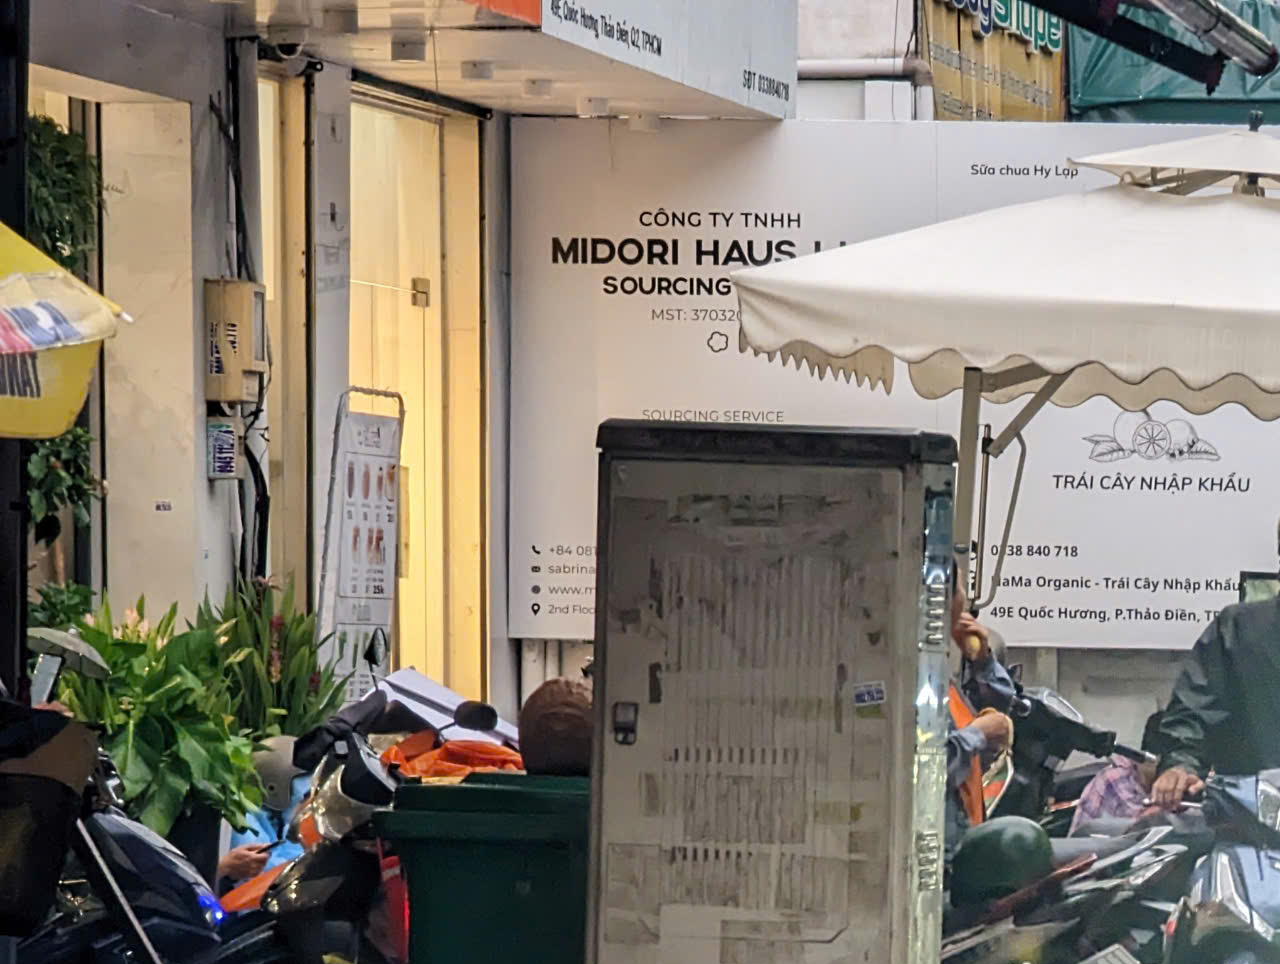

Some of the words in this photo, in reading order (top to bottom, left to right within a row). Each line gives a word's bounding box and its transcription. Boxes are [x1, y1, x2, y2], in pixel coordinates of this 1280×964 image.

[970, 163, 996, 176] Sữa
[999, 164, 1030, 176] chua
[1034, 164, 1052, 178] Hy
[1055, 164, 1079, 180] Lạp
[639, 207, 702, 228] CÔNG
[708, 211, 735, 228] TY
[740, 212, 801, 229] TNHH
[551, 236, 679, 266] MIDORI
[695, 239, 797, 267] HAUS
[602, 275, 732, 296] SOURCING
[651, 308, 688, 321] MST:
[642, 409, 720, 422] SOURCING
[723, 410, 785, 423] SERVICE
[1052, 471, 1094, 489] TRÁI
[1099, 472, 1136, 490] CÂY
[1139, 473, 1193, 495] NHẬP
[1198, 472, 1250, 492] KHẨU
[549, 545, 573, 557] +84
[990, 544, 1023, 556] 038
[1026, 545, 1051, 557] 840
[1054, 545, 1079, 558] 718
[992, 575, 1032, 588] aMa
[1036, 575, 1092, 592] Organic
[1103, 576, 1130, 590] Trái
[1134, 576, 1160, 593] Cây
[1163, 577, 1201, 594] Nhập
[990, 606, 1015, 619] 49E
[1018, 605, 1055, 621] Quốc
[1058, 607, 1111, 624] Hương,
[1115, 606, 1161, 621] P.Thảo
[1164, 608, 1200, 623] Điền,
